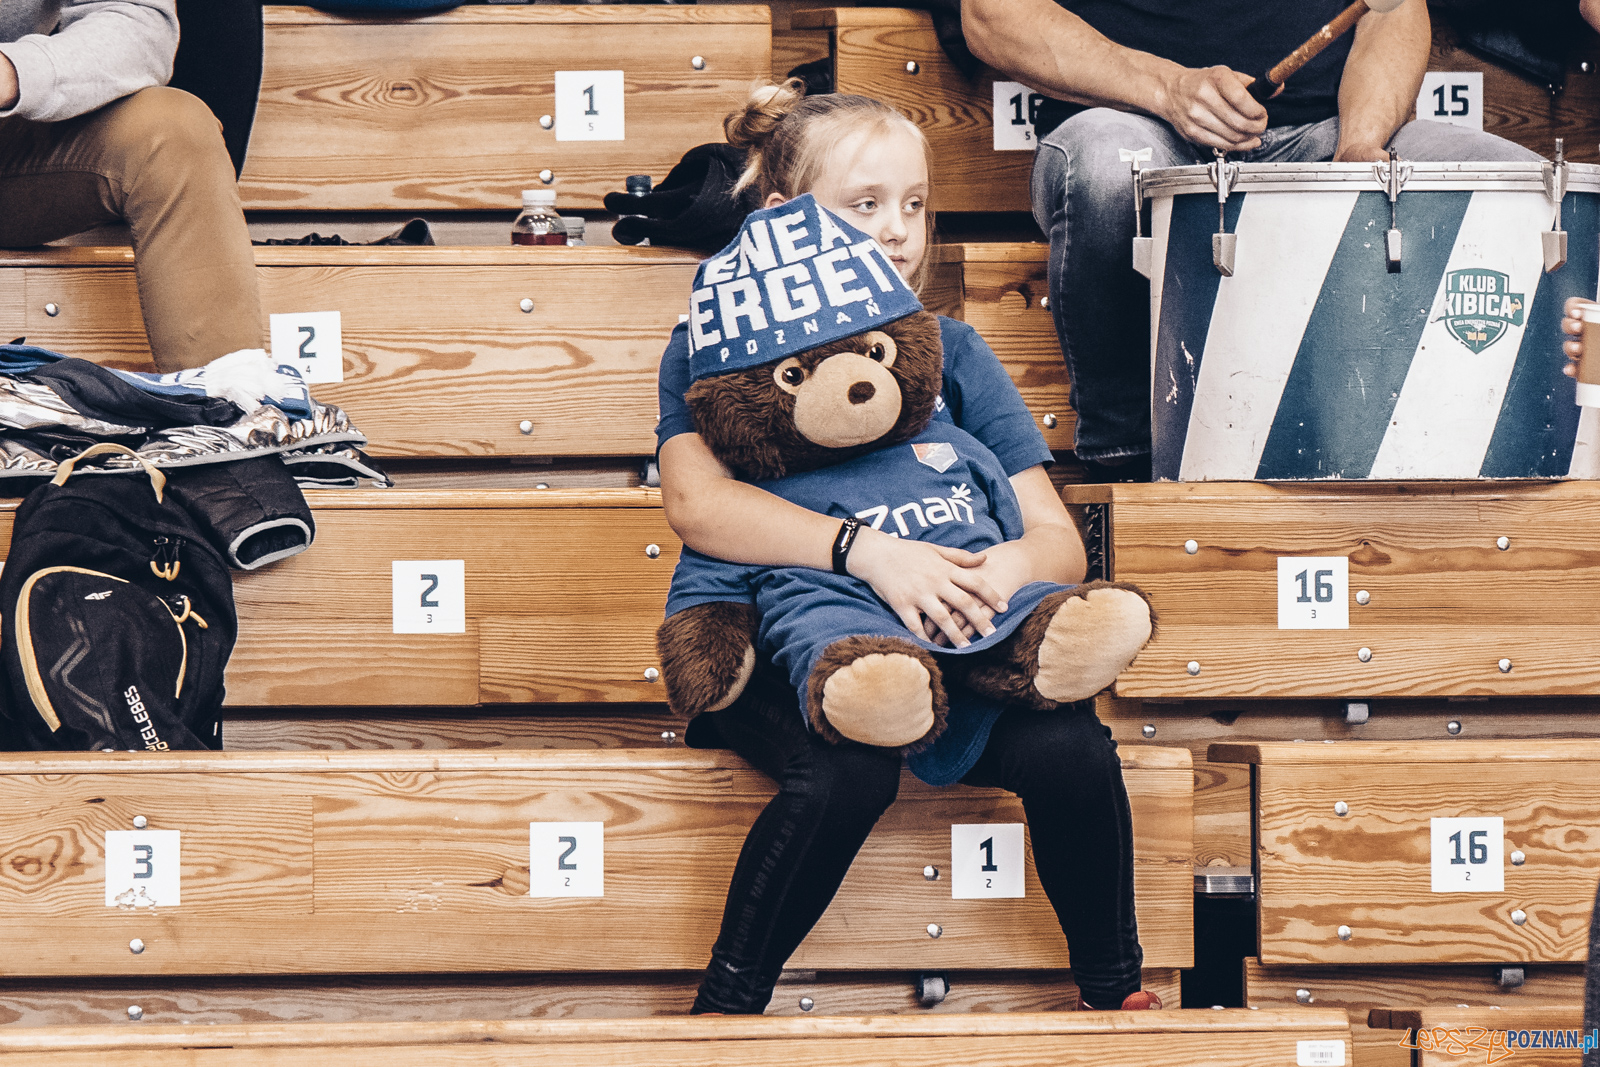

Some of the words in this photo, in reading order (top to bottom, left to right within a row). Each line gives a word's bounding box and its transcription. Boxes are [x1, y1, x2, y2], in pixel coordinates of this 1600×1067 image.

[582, 84, 599, 116] 1
[1433, 84, 1469, 117] 15
[589, 123, 593, 131] 5
[1025, 130, 1032, 141] 5
[703, 203, 852, 287] ENEA
[689, 238, 911, 357] ERGET
[1459, 274, 1497, 293] KLUB
[1446, 293, 1514, 319] KIBICA
[298, 326, 317, 359] 2
[719, 298, 882, 363] POZNAŃ
[306, 365, 311, 374] 4
[420, 573, 439, 608] 2
[1295, 569, 1333, 603] 16
[427, 614, 432, 623] 3
[1311, 609, 1316, 619] 3
[133, 844, 153, 879] 3
[558, 836, 577, 871] 2
[979, 837, 998, 872] 1
[1449, 830, 1488, 865] 16
[565, 877, 570, 886] 2
[986, 878, 992, 888] 2
[1466, 872, 1471, 881] 2
